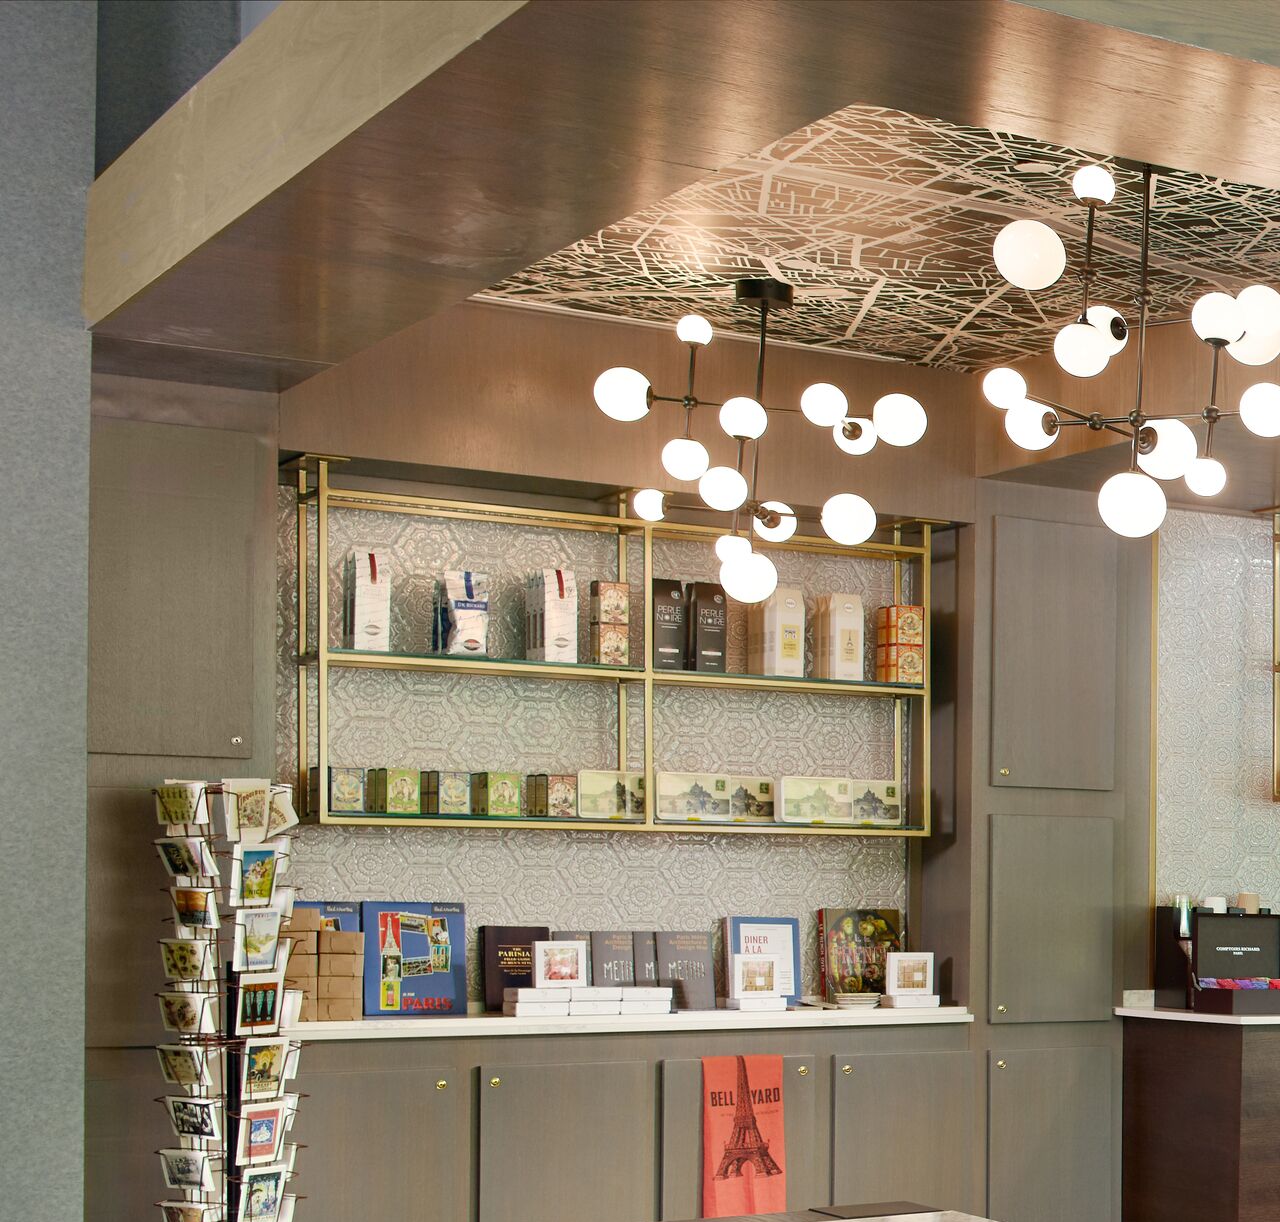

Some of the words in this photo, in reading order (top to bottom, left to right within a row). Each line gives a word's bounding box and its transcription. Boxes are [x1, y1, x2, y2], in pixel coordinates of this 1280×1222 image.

[657, 605, 681, 614] PERLE
[700, 608, 724, 618] PERLE
[744, 935, 769, 944] DINER
[752, 945, 762, 953] LA
[402, 996, 453, 1010] PARIS
[710, 1090, 736, 1107] BELL
[750, 1087, 781, 1105] YARD
